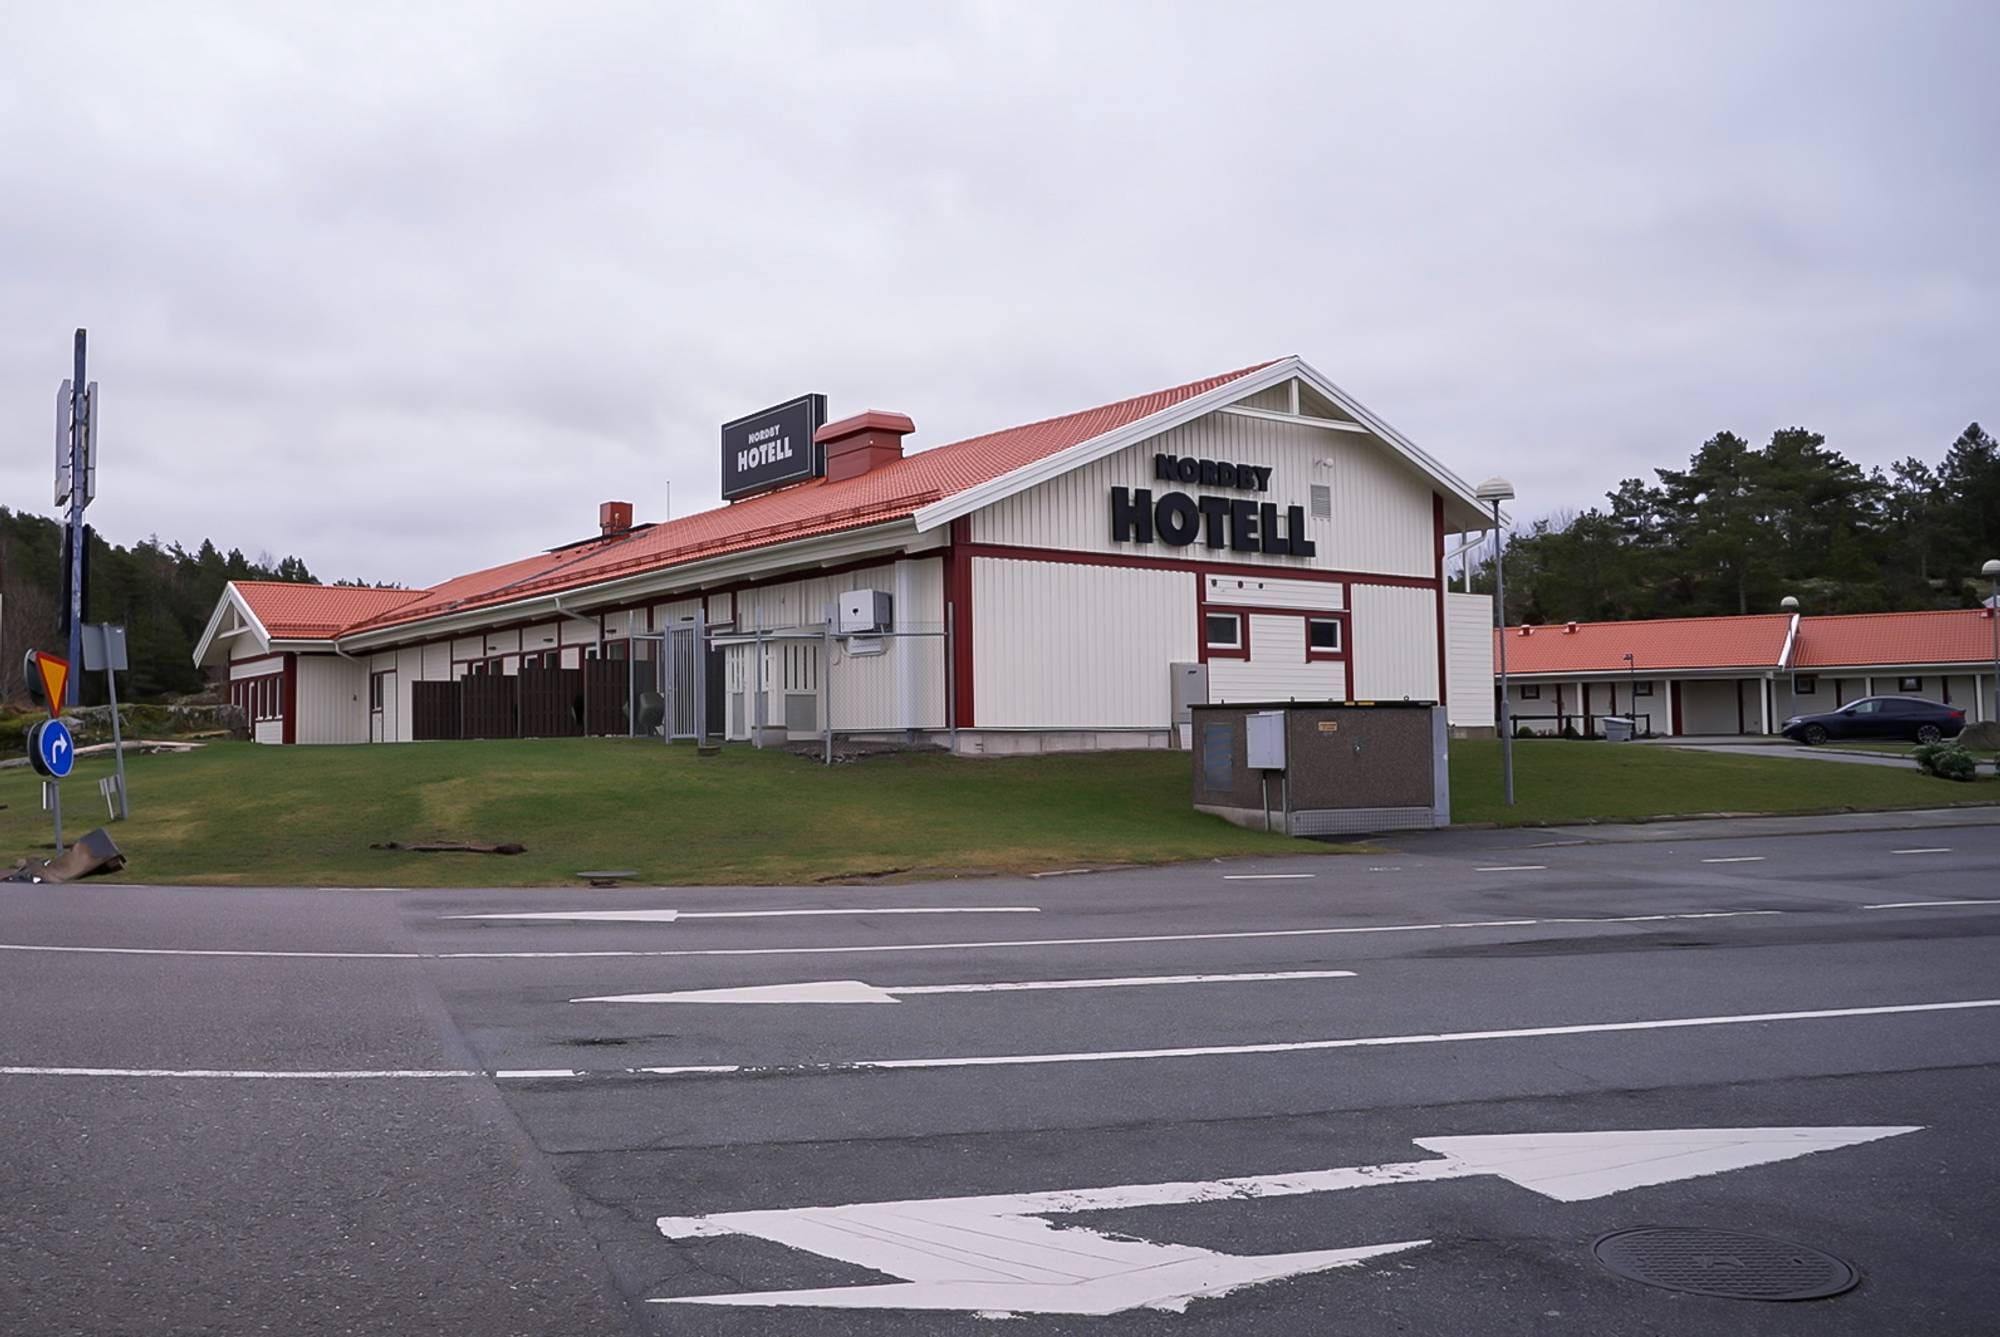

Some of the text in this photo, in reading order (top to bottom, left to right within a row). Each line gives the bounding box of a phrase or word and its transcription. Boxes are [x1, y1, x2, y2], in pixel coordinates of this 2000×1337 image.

[737, 436, 793, 472] HOTELL
[1155, 453, 1273, 492] NORDBY
[1111, 486, 1316, 557] HOTELL
